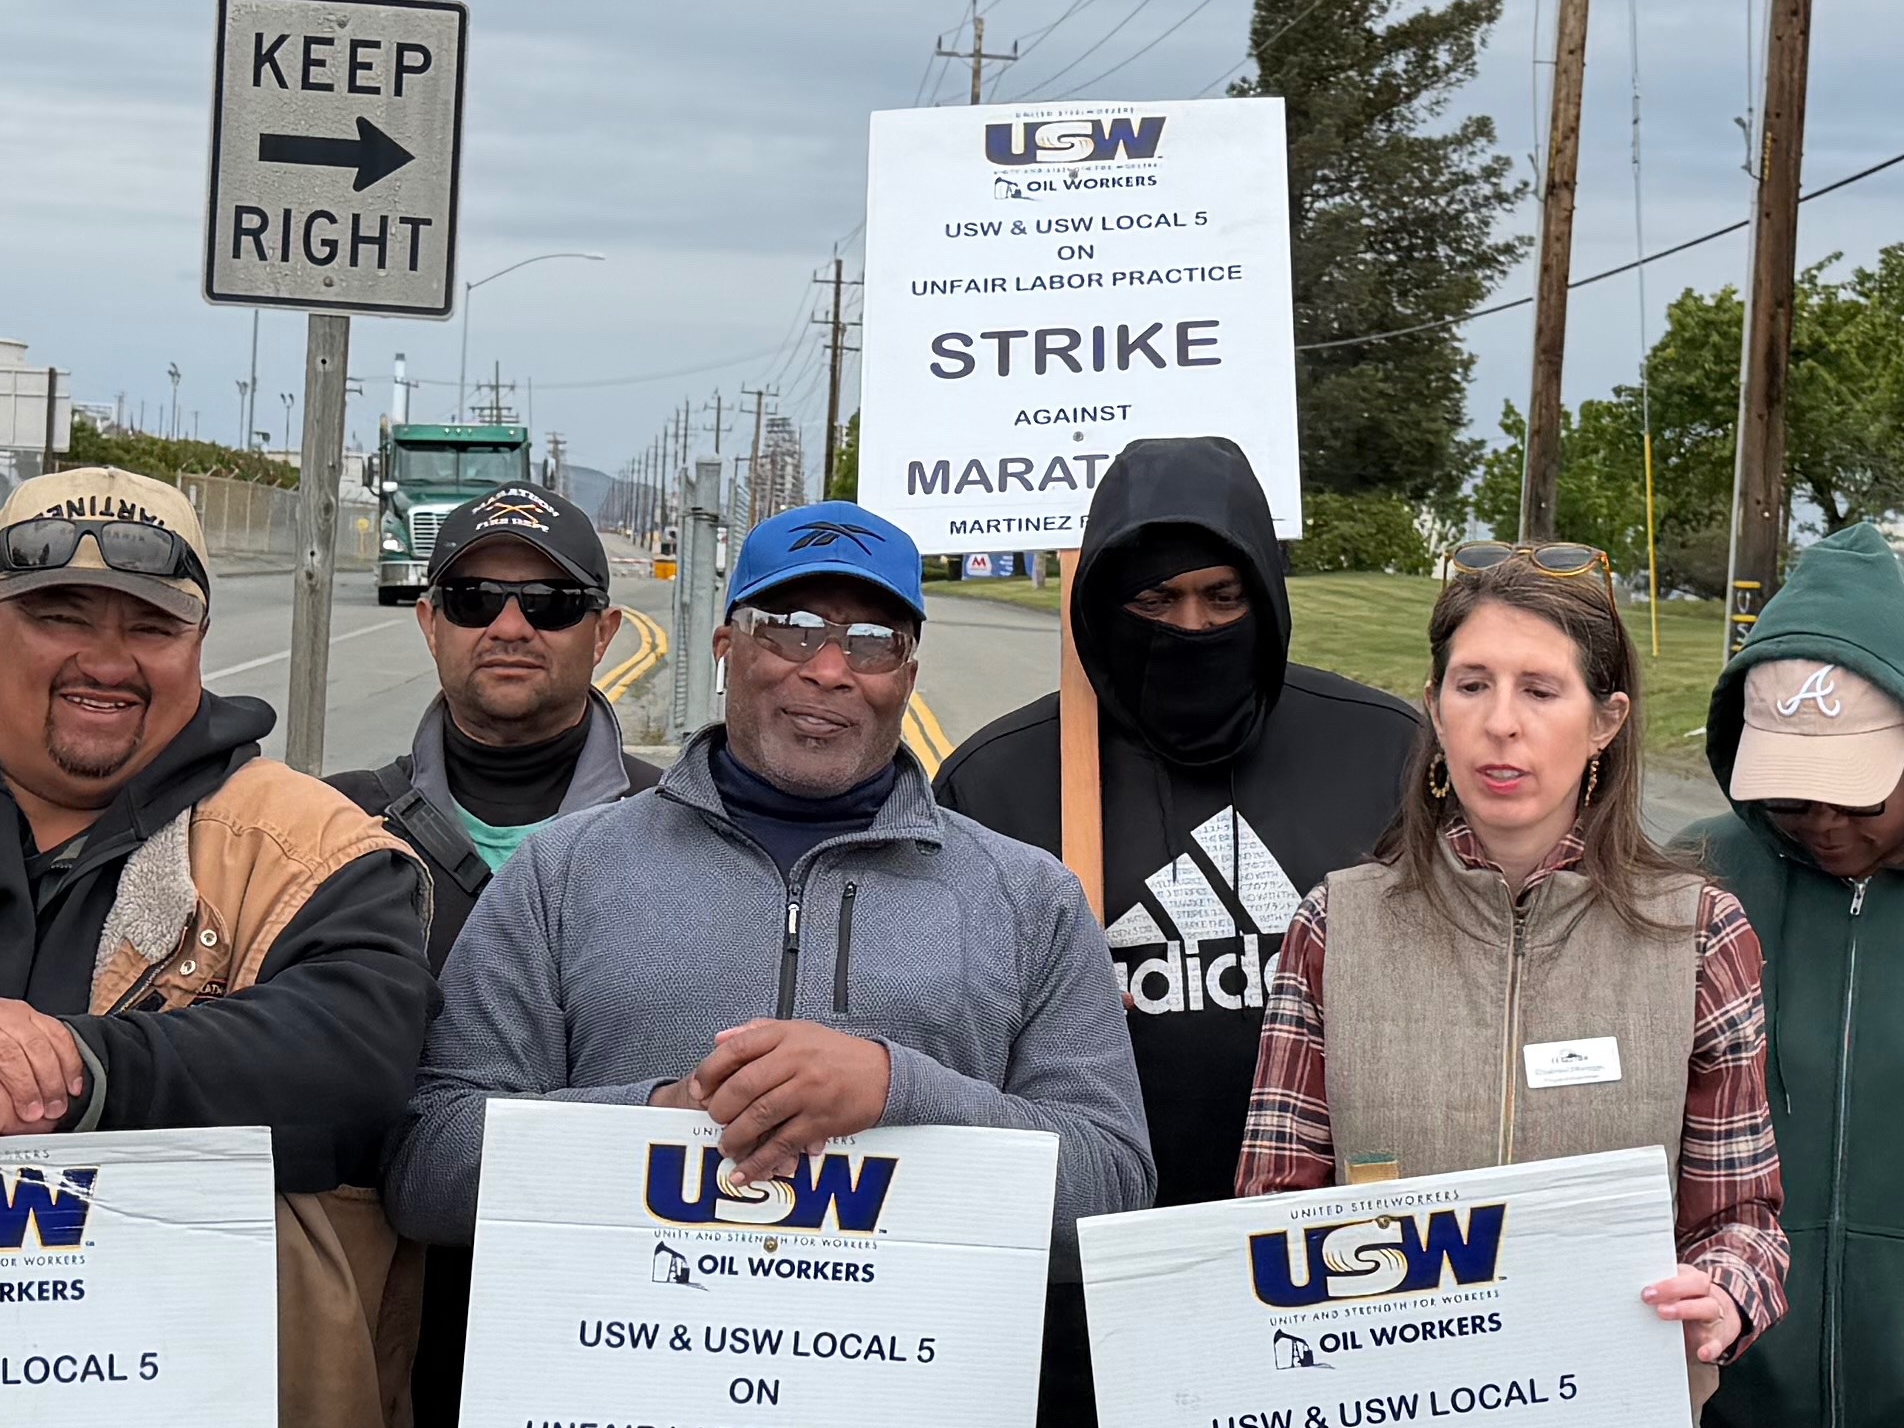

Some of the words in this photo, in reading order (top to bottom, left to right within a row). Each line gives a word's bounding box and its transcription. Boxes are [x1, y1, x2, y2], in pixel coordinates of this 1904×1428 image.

[253, 32, 432, 97] KEEP
[985, 117, 1166, 165] USW
[1027, 180, 1057, 192] OIL
[1063, 175, 1158, 191] WORKERS
[232, 205, 432, 272] RIGHT
[946, 221, 1002, 238] USW
[1010, 220, 1027, 235] &
[1036, 216, 1093, 234] USW
[1102, 213, 1187, 230] LOCAL
[1195, 211, 1207, 225] 5
[1058, 245, 1094, 260] ON
[912, 278, 1006, 296] UNFAIR
[1016, 273, 1103, 291] LABOR
[1112, 265, 1242, 286] PRACTICE
[930, 320, 1221, 379] STRIKE
[1014, 405, 1132, 426] AGAINST
[907, 454, 1109, 496] MARAT
[35, 496, 164, 526] ARTINE
[950, 516, 1072, 535] MARTINEZ
[645, 1144, 899, 1232] USW
[1291, 1205, 1343, 1219] UNITED
[1352, 1190, 1459, 1212] STEELWORKERS
[24, 1255, 85, 1266] WORKERS
[698, 1255, 738, 1275] OIL
[748, 1257, 874, 1283] WORKERS
[1248, 1202, 1507, 1308] USW
[580, 1320, 659, 1349] USW
[669, 1324, 692, 1351] &
[705, 1326, 783, 1355] USW
[793, 1331, 907, 1361] LOCAL
[917, 1338, 935, 1363] 5
[1320, 1331, 1362, 1353] OIL
[1370, 1313, 1502, 1346] WORKERS
[2, 1354, 128, 1384] LOCAL
[139, 1352, 158, 1380] 5
[730, 1378, 779, 1405] ON
[1339, 1393, 1418, 1427] USW
[1430, 1378, 1549, 1416] LOCAL
[1560, 1374, 1577, 1400] 5
